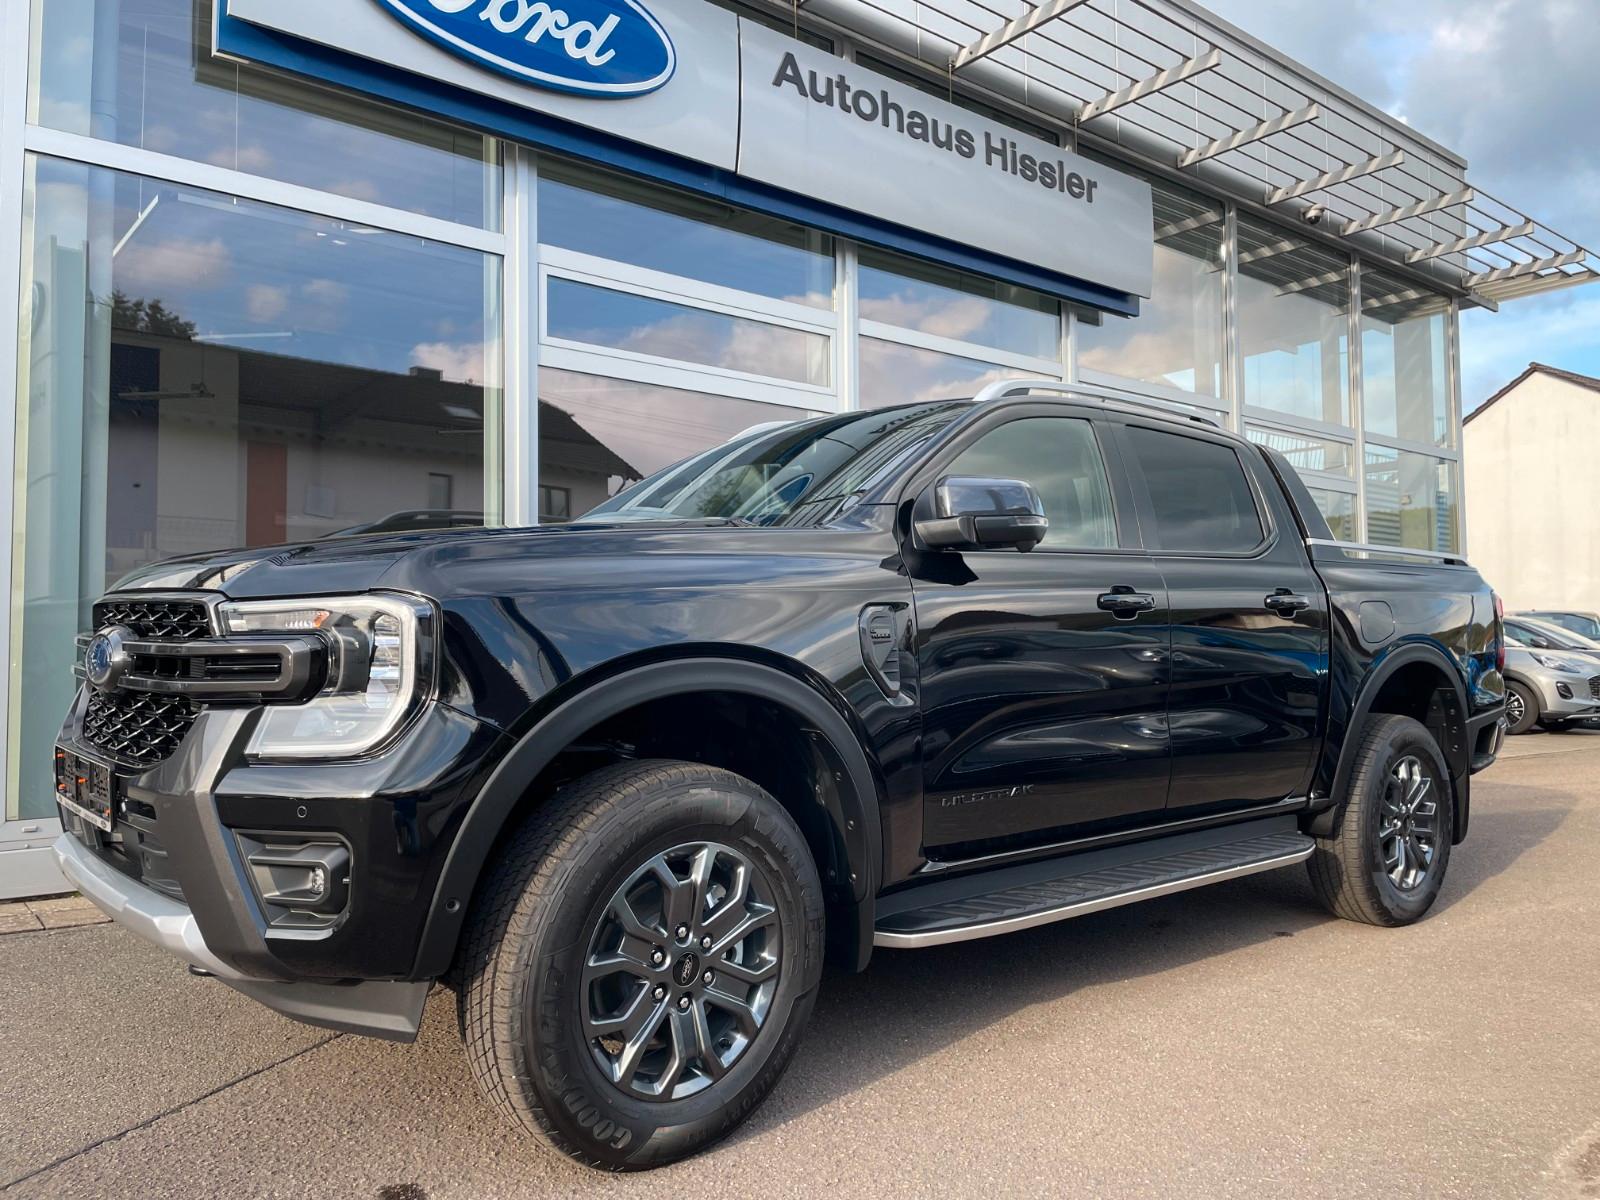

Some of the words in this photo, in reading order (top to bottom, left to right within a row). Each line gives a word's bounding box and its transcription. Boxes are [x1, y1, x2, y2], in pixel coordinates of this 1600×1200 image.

[427, 0, 621, 66] ord
[772, 51, 976, 159] Autohaus
[984, 131, 1098, 203] Hissler
